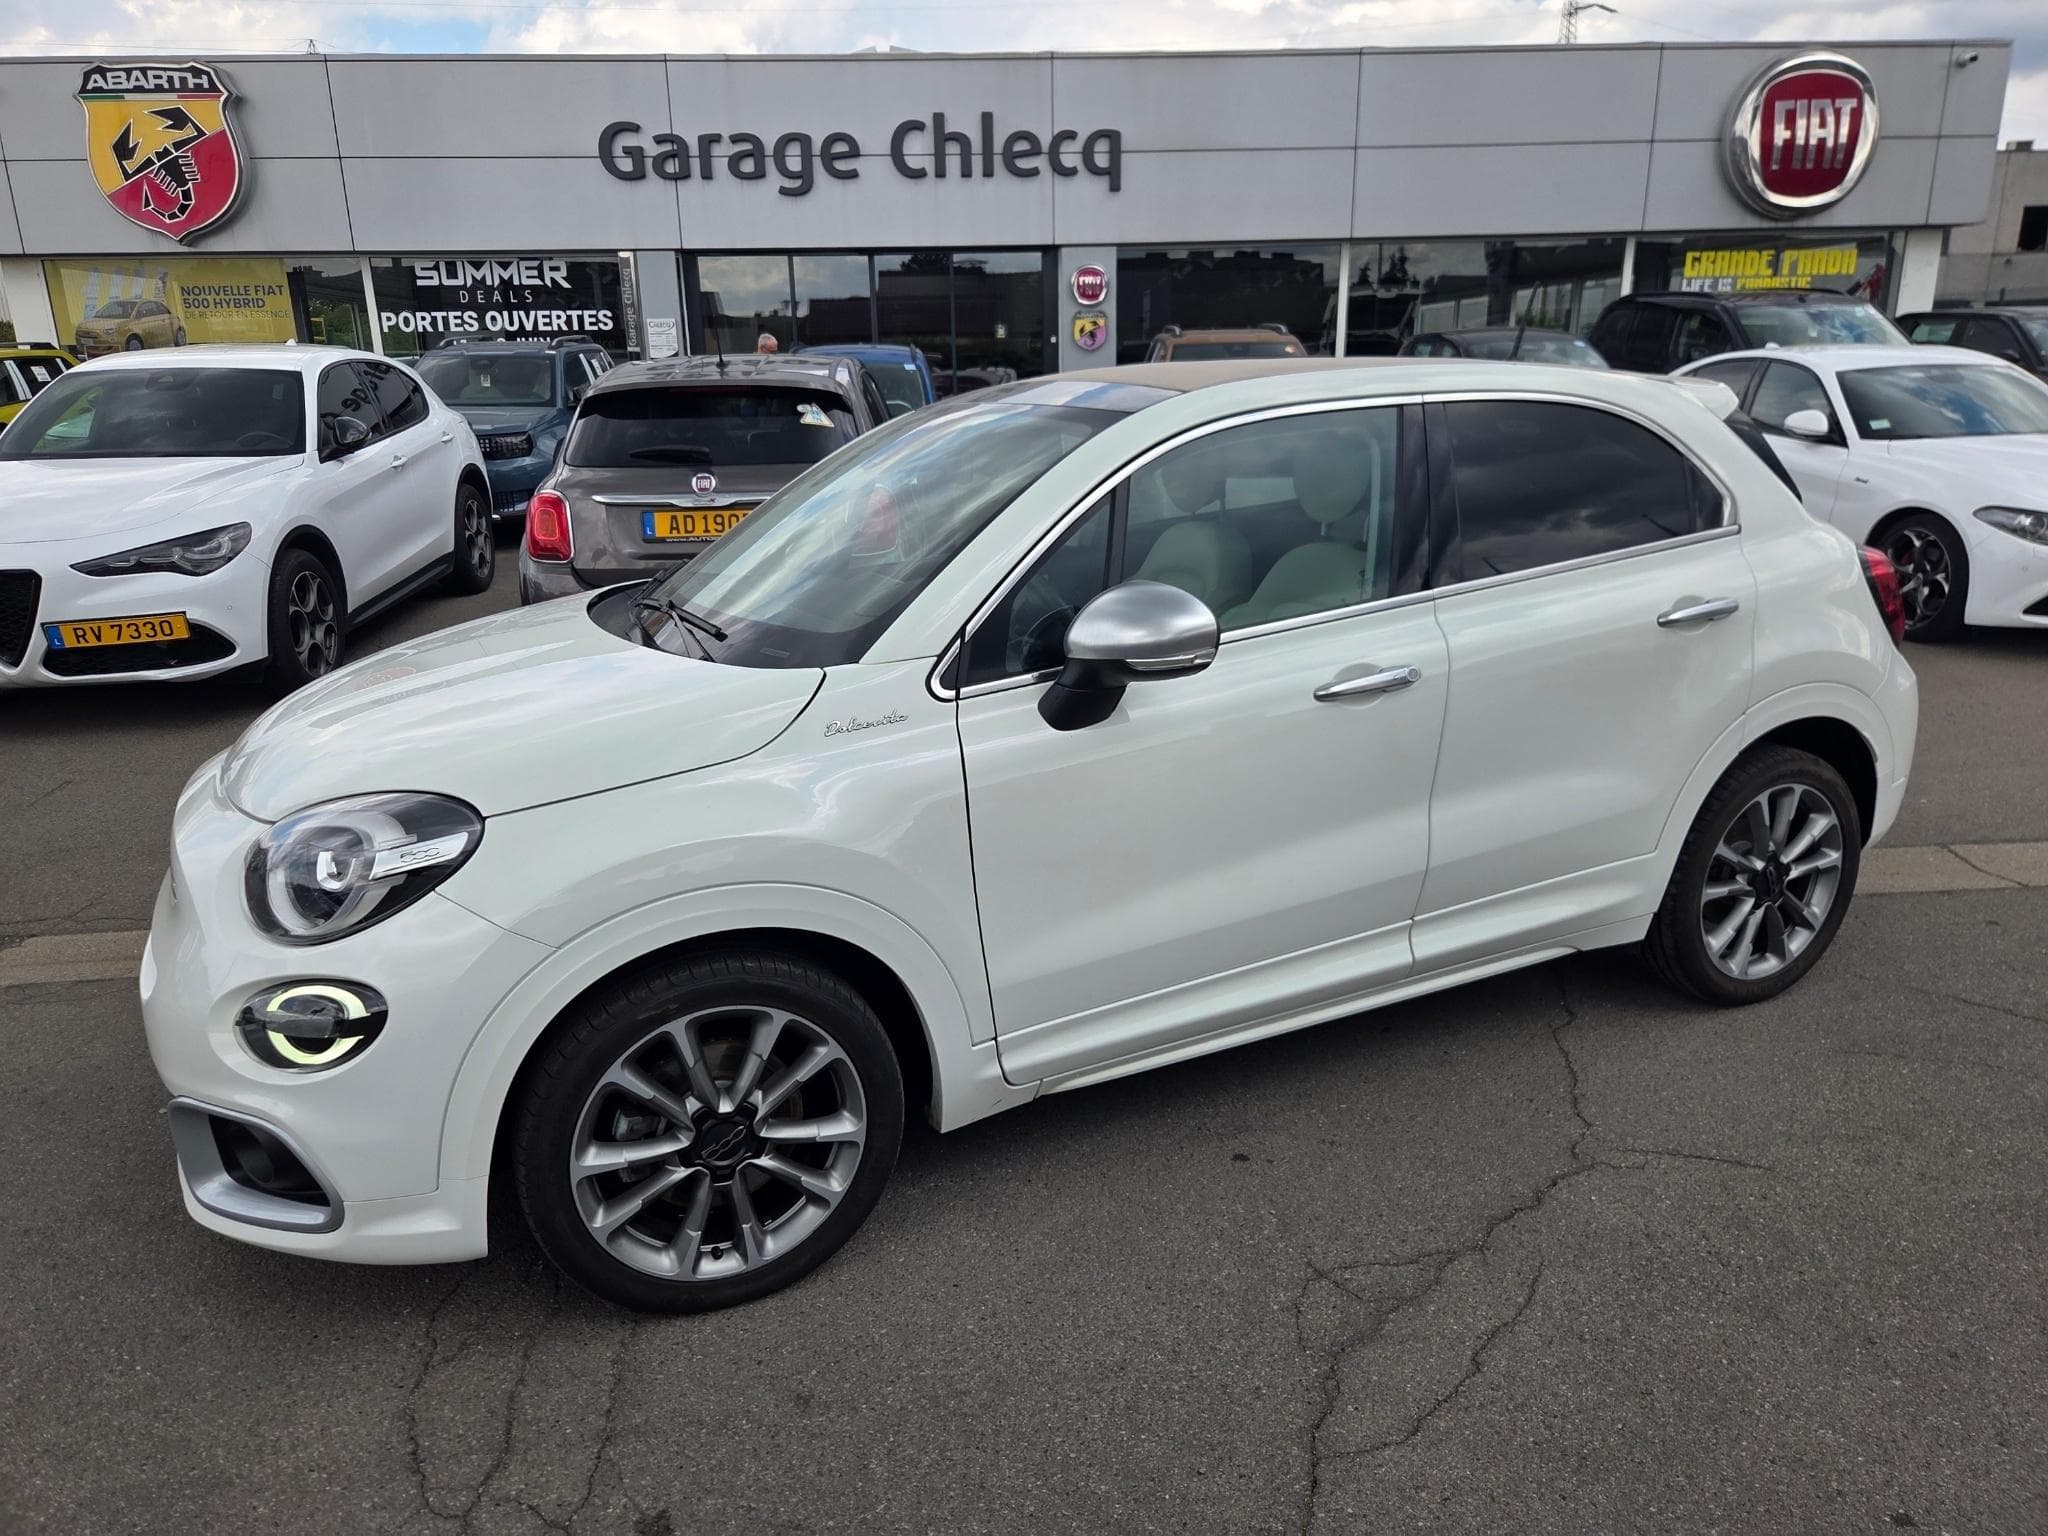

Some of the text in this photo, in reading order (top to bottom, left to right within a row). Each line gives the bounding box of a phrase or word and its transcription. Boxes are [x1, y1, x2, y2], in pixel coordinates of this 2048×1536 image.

[86, 70, 210, 90] ABARTH
[1771, 98, 1858, 170] FIAT
[598, 111, 1122, 197] Garage Chlecq
[414, 259, 573, 289] SUMMER
[1683, 249, 1858, 278] GRANDE PANDA
[180, 284, 284, 297] NOUVELLE FIAT
[460, 289, 534, 303] DEALS
[1681, 278, 1714, 292] LIFE
[1717, 278, 1733, 292] IS
[183, 297, 266, 309] 500 HYBRID
[622, 268, 637, 346] Garage Chlecq
[380, 309, 614, 333] PORTES OUVERTES
[697, 479, 711, 489] FIAT
[669, 514, 696, 535] AD
[702, 513, 749, 534] 190
[72, 625, 102, 645] RV
[110, 619, 174, 642] 7330
